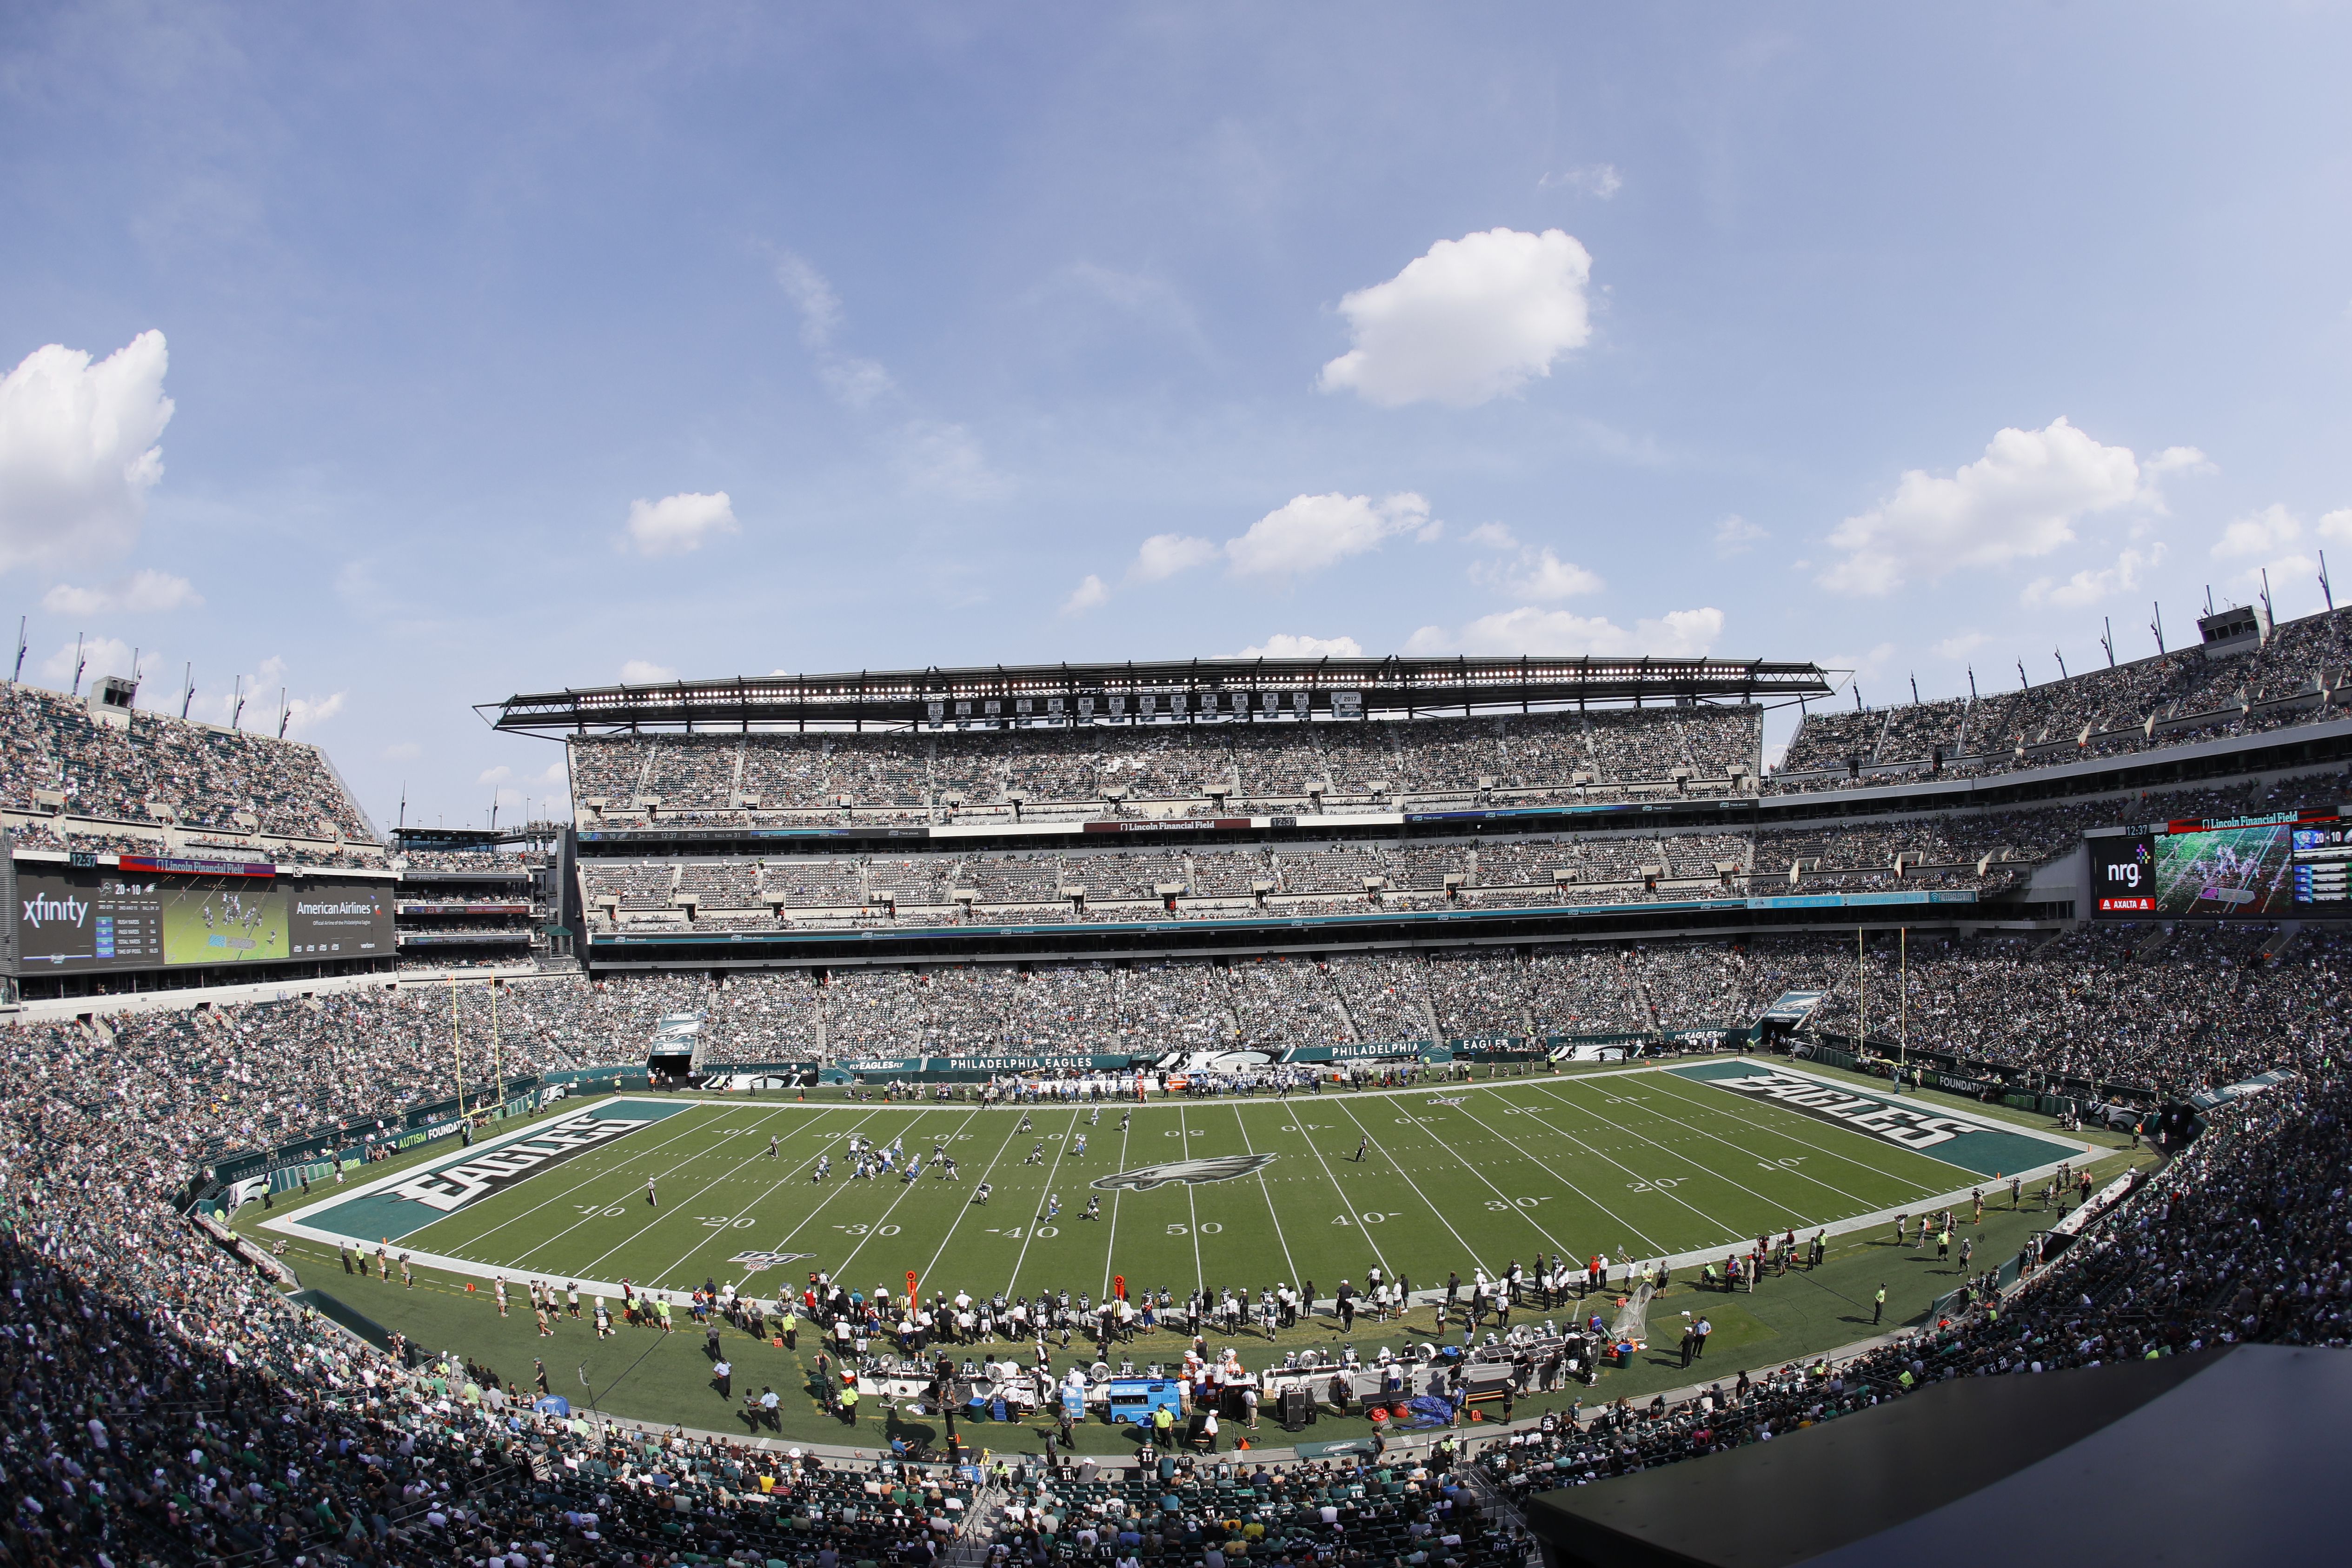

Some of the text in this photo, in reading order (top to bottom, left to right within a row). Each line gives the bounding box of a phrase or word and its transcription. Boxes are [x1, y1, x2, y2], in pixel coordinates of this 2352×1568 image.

[1159, 821, 1194, 830] Financial
[1195, 820, 1215, 829] Field
[1273, 818, 1296, 826] 12:37
[2211, 811, 2298, 829] Lincoln Financial Field
[2126, 824, 2147, 836] 12:37
[2314, 833, 2324, 844] 20
[2331, 831, 2341, 842] 10
[72, 854, 97, 867] 12:37
[165, 859, 244, 874] Lincoln Financial Field
[2108, 863, 2139, 888] nrg
[115, 884, 125, 895] 20
[132, 884, 140, 895] 10
[23, 892, 88, 928] xfinity
[296, 901, 371, 915] American Airlines
[2114, 900, 2137, 909] AXALTA
[1684, 1030, 1718, 1040] EAGLES
[1332, 1043, 1419, 1056] PHILADELPHIA
[859, 1061, 893, 1070] EAGLES
[950, 1057, 1092, 1070] PHILADELPHIA EAGLES
[1503, 1106, 1541, 1115] 20
[1703, 1071, 2009, 1150] EAGLES
[1395, 1116, 1434, 1124] 30
[399, 1131, 427, 1149] AUTISM
[356, 1112, 657, 1212] EAGLES
[1757, 1157, 1800, 1171] 10
[1626, 1177, 1679, 1193] 20
[1484, 1196, 1539, 1211] 30
[578, 1205, 626, 1217] 10
[701, 1216, 756, 1229] 20
[1330, 1211, 1386, 1226] 40
[845, 1223, 901, 1236] 30
[1003, 1226, 1060, 1239] 40
[1166, 1222, 1223, 1236] 50
[774, 1339, 783, 1347] 30
[1768, 1382, 1777, 1391] 91
[1542, 1420, 1554, 1431] 25
[703, 1446, 712, 1455] 91
[1142, 1452, 1153, 1462] 11
[883, 1465, 893, 1474] 86
[1024, 1468, 1033, 1477] 11
[1062, 1470, 1071, 1480] 11
[804, 1478, 813, 1486] 11
[962, 1472, 973, 1481] 29
[810, 1510, 815, 1519] 9
[1429, 1512, 1439, 1522] 43
[535, 1517, 544, 1528] 11
[1100, 1546, 1112, 1557] 11
[1517, 1547, 1528, 1558] 11
